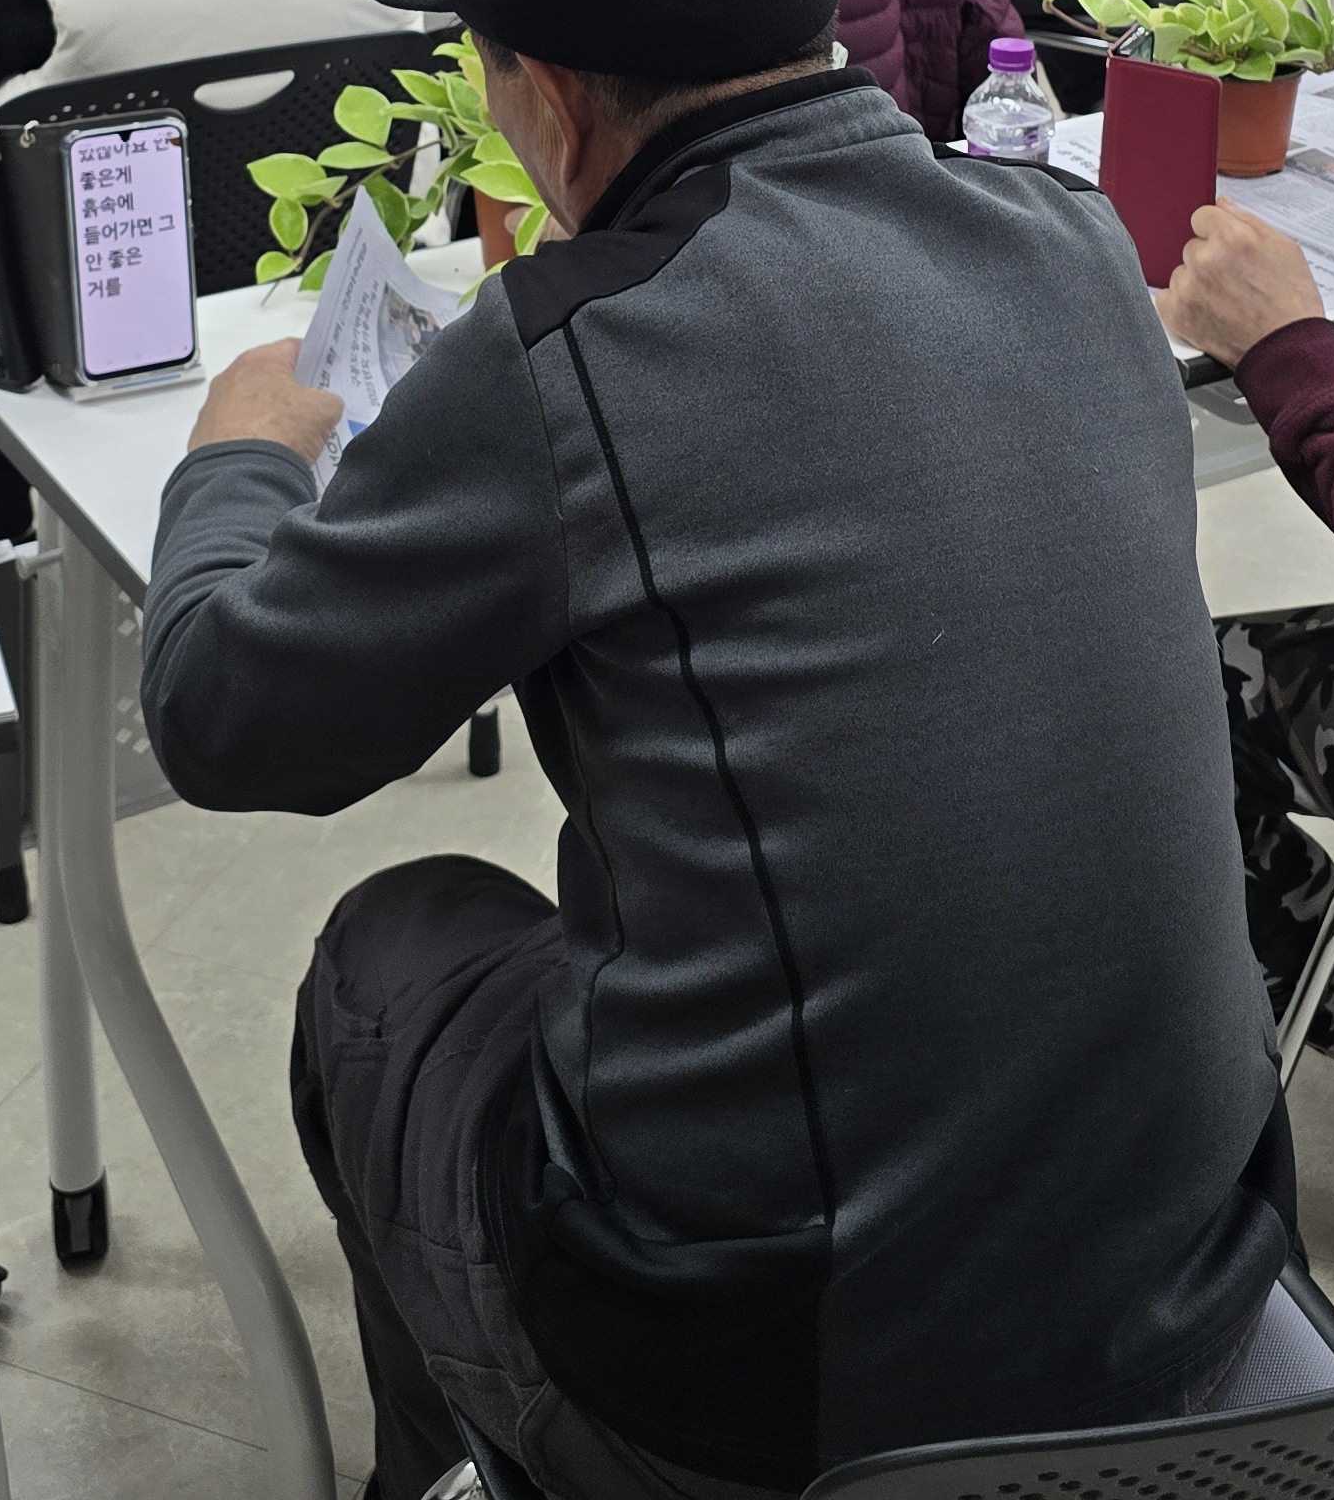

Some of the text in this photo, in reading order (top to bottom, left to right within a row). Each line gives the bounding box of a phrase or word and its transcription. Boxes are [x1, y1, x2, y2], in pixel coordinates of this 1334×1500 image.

[80, 164, 132, 191] 좋은게
[82, 192, 134, 219] 흙속에
[84, 214, 176, 246] 들어가면 그
[85, 246, 143, 272] 안 좋은
[87, 276, 122, 299] 거를
